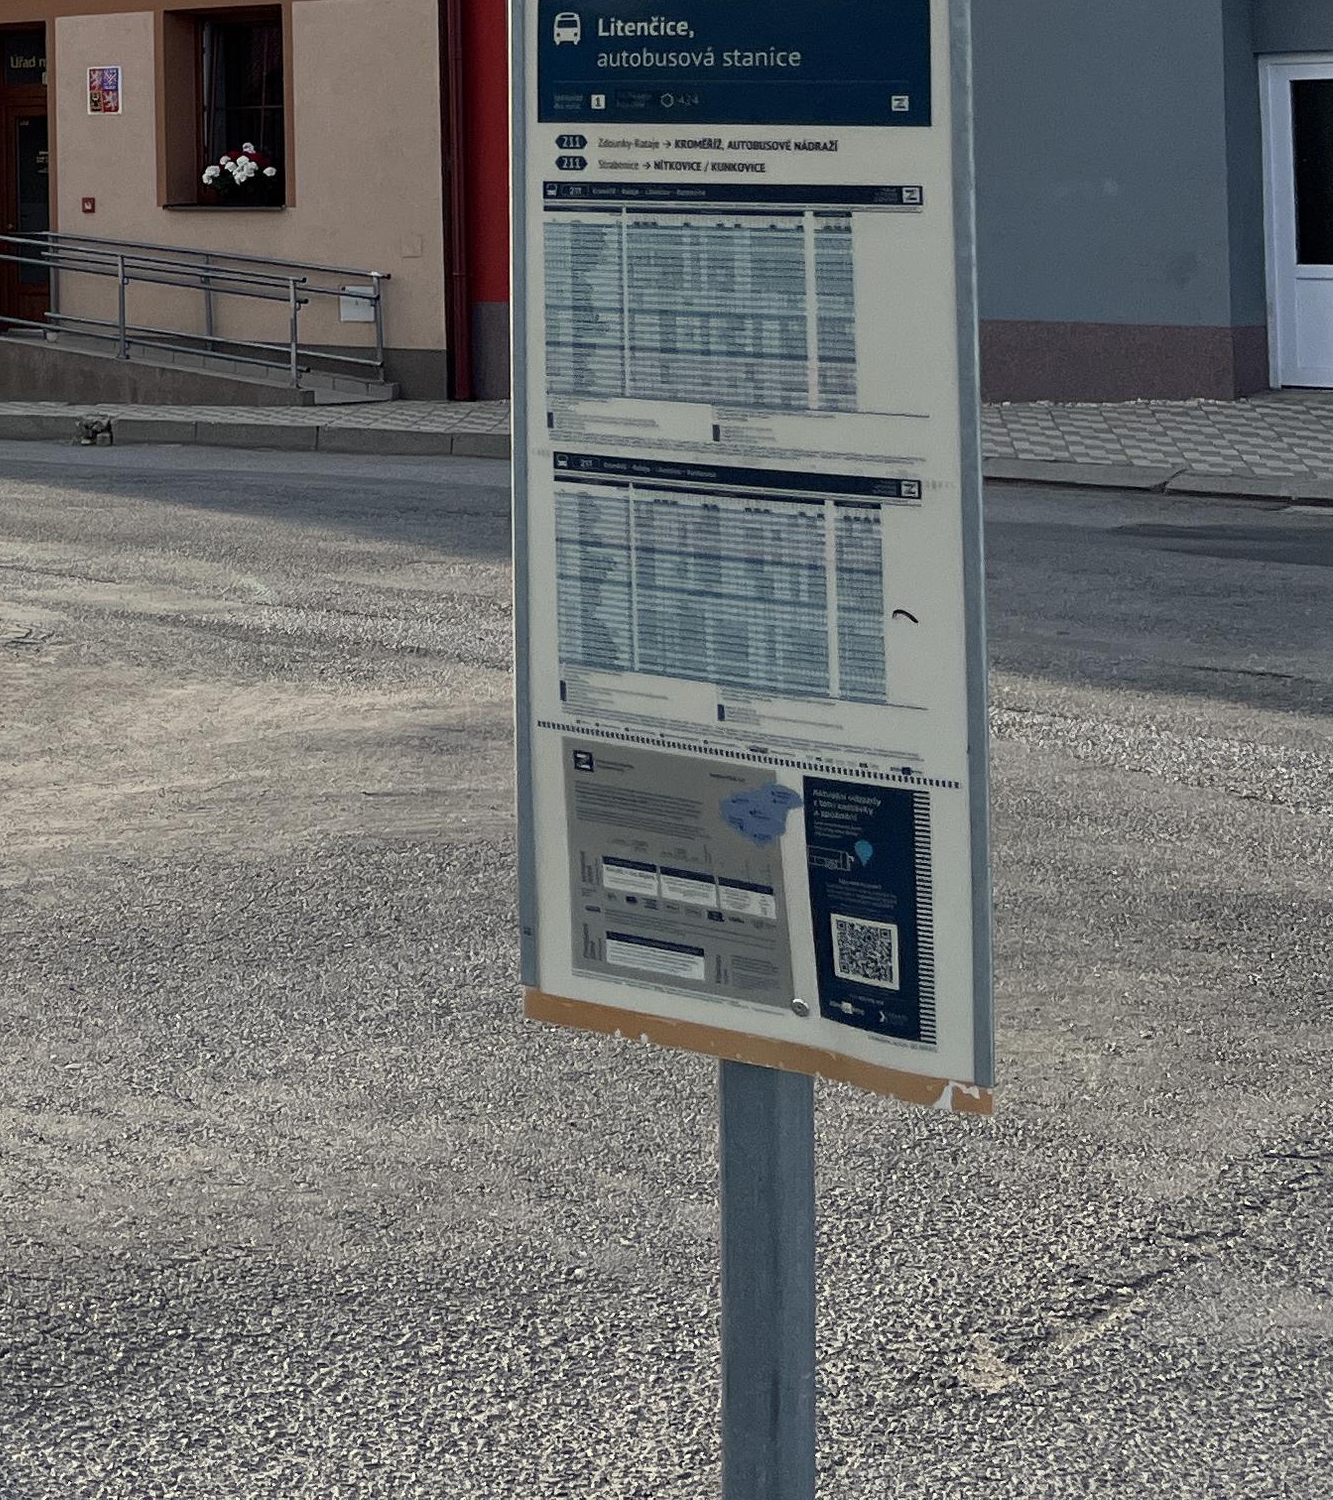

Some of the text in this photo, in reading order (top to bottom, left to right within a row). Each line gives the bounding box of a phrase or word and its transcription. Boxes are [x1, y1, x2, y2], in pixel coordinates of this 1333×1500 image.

[597, 15, 695, 38] Litenčice,
[597, 47, 801, 68] autobusová stanice
[595, 96, 601, 107] 1
[562, 136, 581, 148] 211
[562, 157, 581, 169] 211
